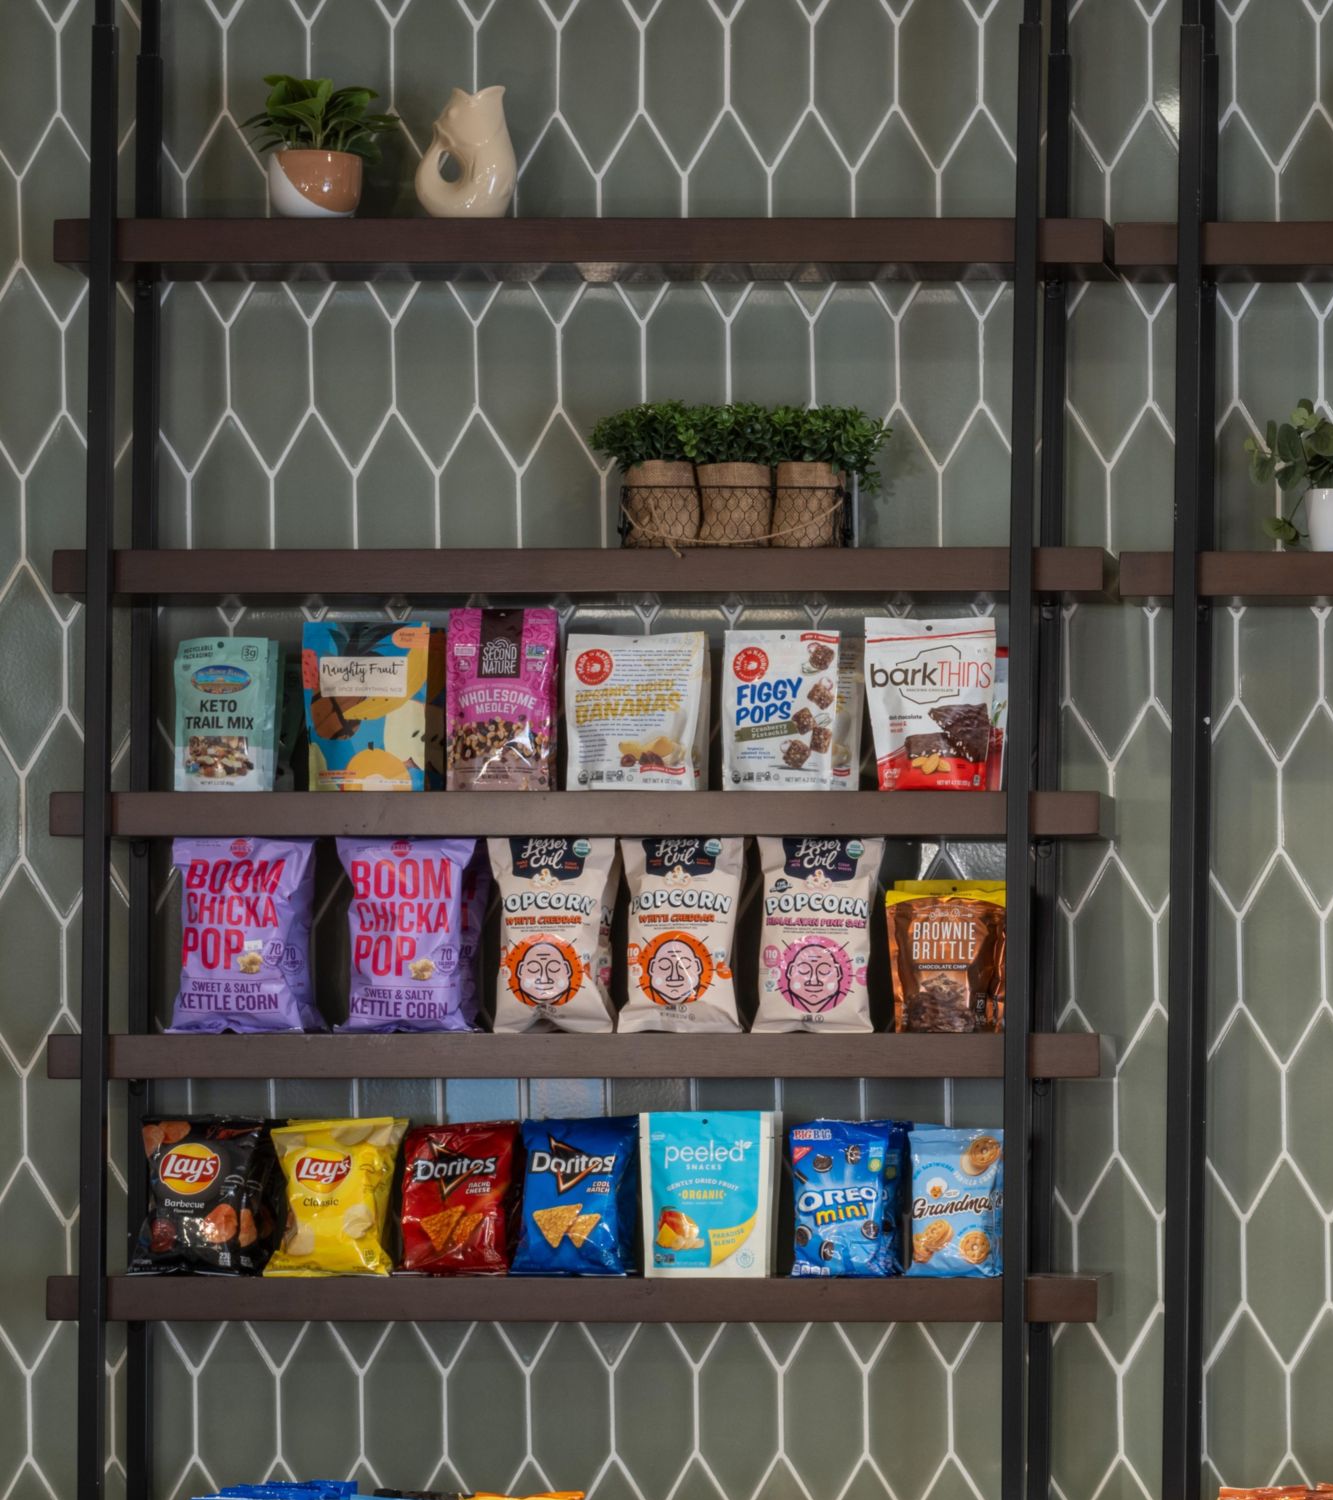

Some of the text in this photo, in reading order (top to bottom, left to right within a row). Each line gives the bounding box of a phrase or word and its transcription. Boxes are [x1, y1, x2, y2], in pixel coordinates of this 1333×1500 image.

[243, 647, 256, 659] 3g
[483, 647, 517, 661] SECOND
[322, 663, 404, 682] Naughty Fruit
[482, 660, 516, 674] NATURE
[459, 690, 537, 709] WHOLESOME
[736, 677, 803, 706] FIGGY
[200, 700, 237, 712] KETO
[476, 702, 518, 714] MEDLEY
[576, 691, 681, 725] BANANAS
[735, 701, 792, 726] POPS
[185, 716, 254, 729] TRAIL MIX
[530, 850, 563, 869] Evil
[664, 848, 694, 866] Evil
[803, 851, 835, 869] Evil
[186, 859, 285, 895] BOOM
[352, 858, 452, 900] BOOM
[188, 893, 279, 928] CHICKA
[503, 892, 596, 916] OPCORN
[632, 888, 732, 914] POPCORN
[766, 893, 869, 918] POPCORN
[357, 901, 449, 933] CHICKA
[505, 915, 582, 926] WHITE CHEDDAR
[639, 913, 715, 924] WHITE CHEDDAR
[766, 917, 866, 928] HIMALAYAN PINK SALT
[913, 922, 976, 941] BROWNIE
[182, 928, 245, 970] POP
[270, 943, 281, 956] 70
[354, 935, 417, 976] POP
[440, 948, 452, 961] 70
[912, 941, 976, 960] BRITTLE
[191, 981, 262, 994] SWEET & SALTY
[364, 987, 434, 1000] SWEET & SALTY
[179, 992, 279, 1011] KETTLE CORN
[351, 997, 448, 1020] KETTLE CORN
[793, 1129, 832, 1140] BIG BAG
[532, 1152, 616, 1174] Doritos
[664, 1139, 745, 1169] peeled
[163, 1154, 217, 1183] Lay's
[298, 1158, 350, 1185] Lay's
[414, 1157, 496, 1181] Doritos
[667, 1178, 694, 1192] GENTLY
[718, 1180, 739, 1192] FRUIT
[165, 1198, 205, 1209] Barbecue
[303, 1197, 339, 1207] Classic
[681, 1190, 724, 1200] ORGANIC
[798, 1187, 877, 1213] OREO
[816, 1202, 867, 1225] mini
